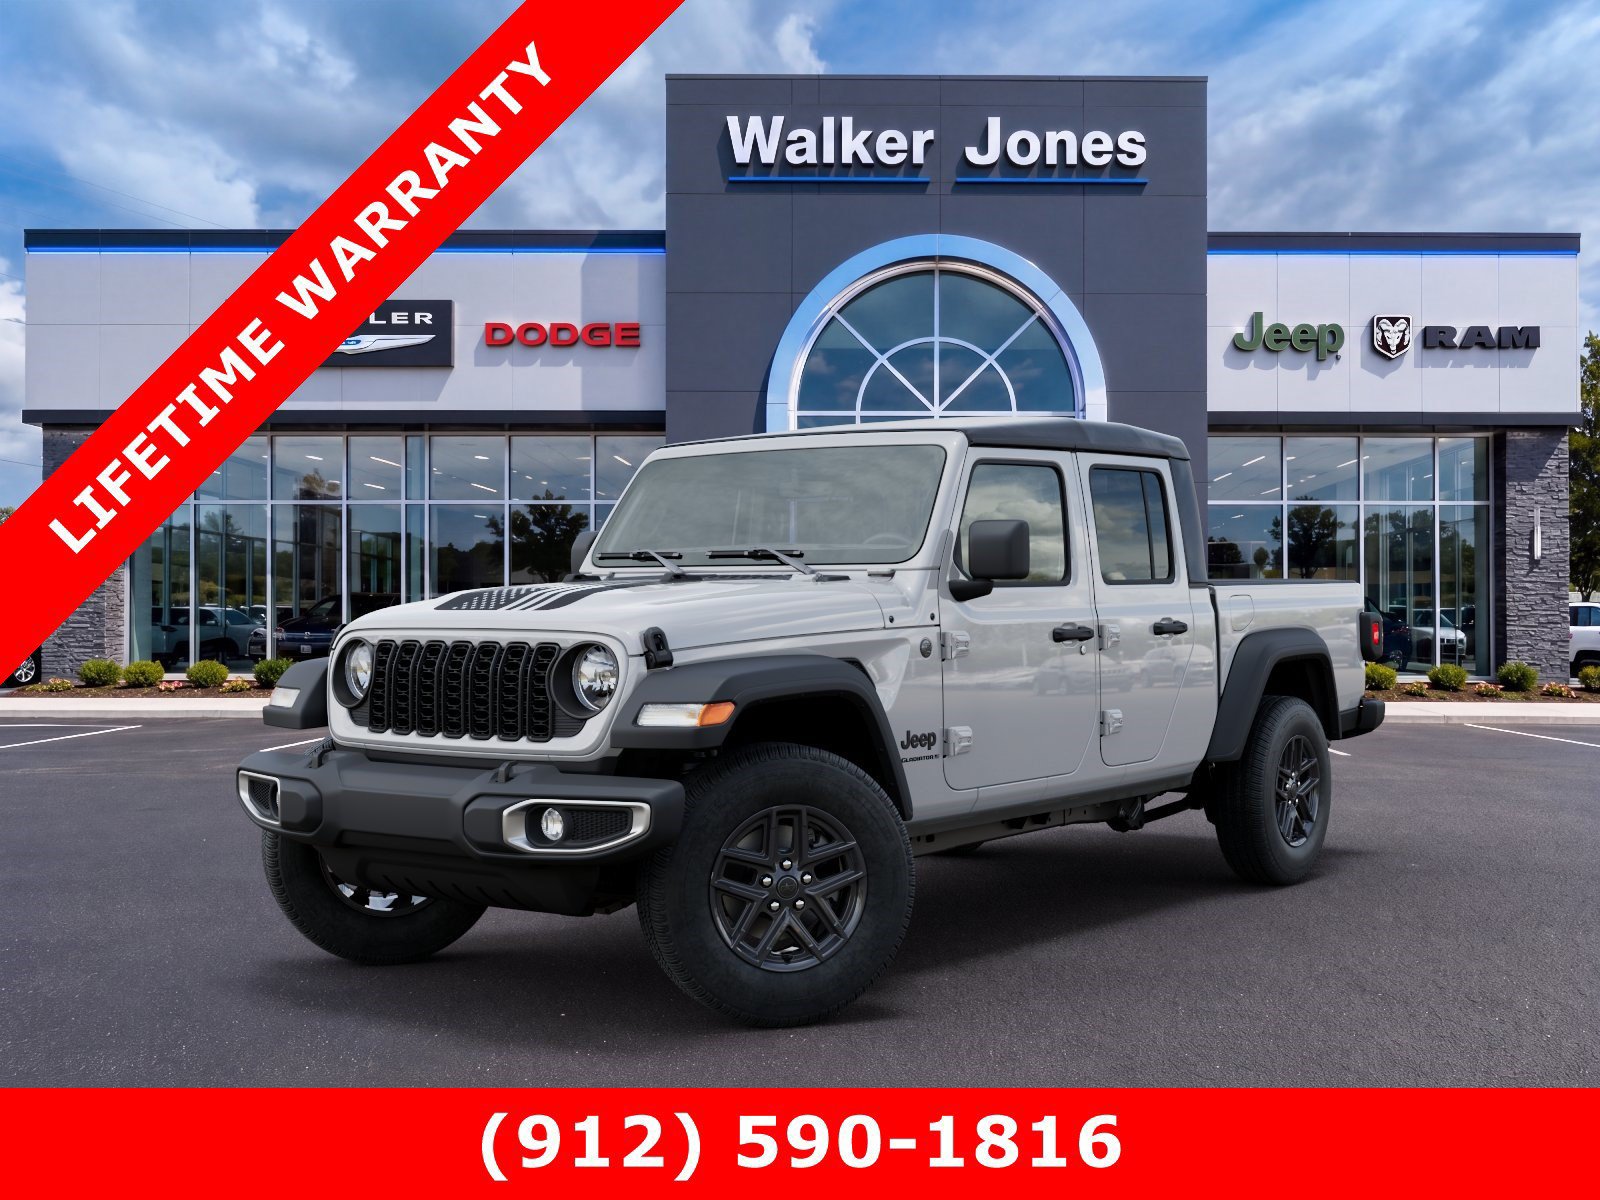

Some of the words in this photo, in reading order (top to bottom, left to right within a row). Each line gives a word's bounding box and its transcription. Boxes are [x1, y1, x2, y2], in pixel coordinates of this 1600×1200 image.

[726, 115, 935, 166] Walker
[964, 116, 1147, 167] Jones
[485, 322, 641, 347] DODGE
[1234, 311, 1345, 361] Jeep
[1423, 325, 1541, 349] RAM
[900, 730, 937, 750] Jeep
